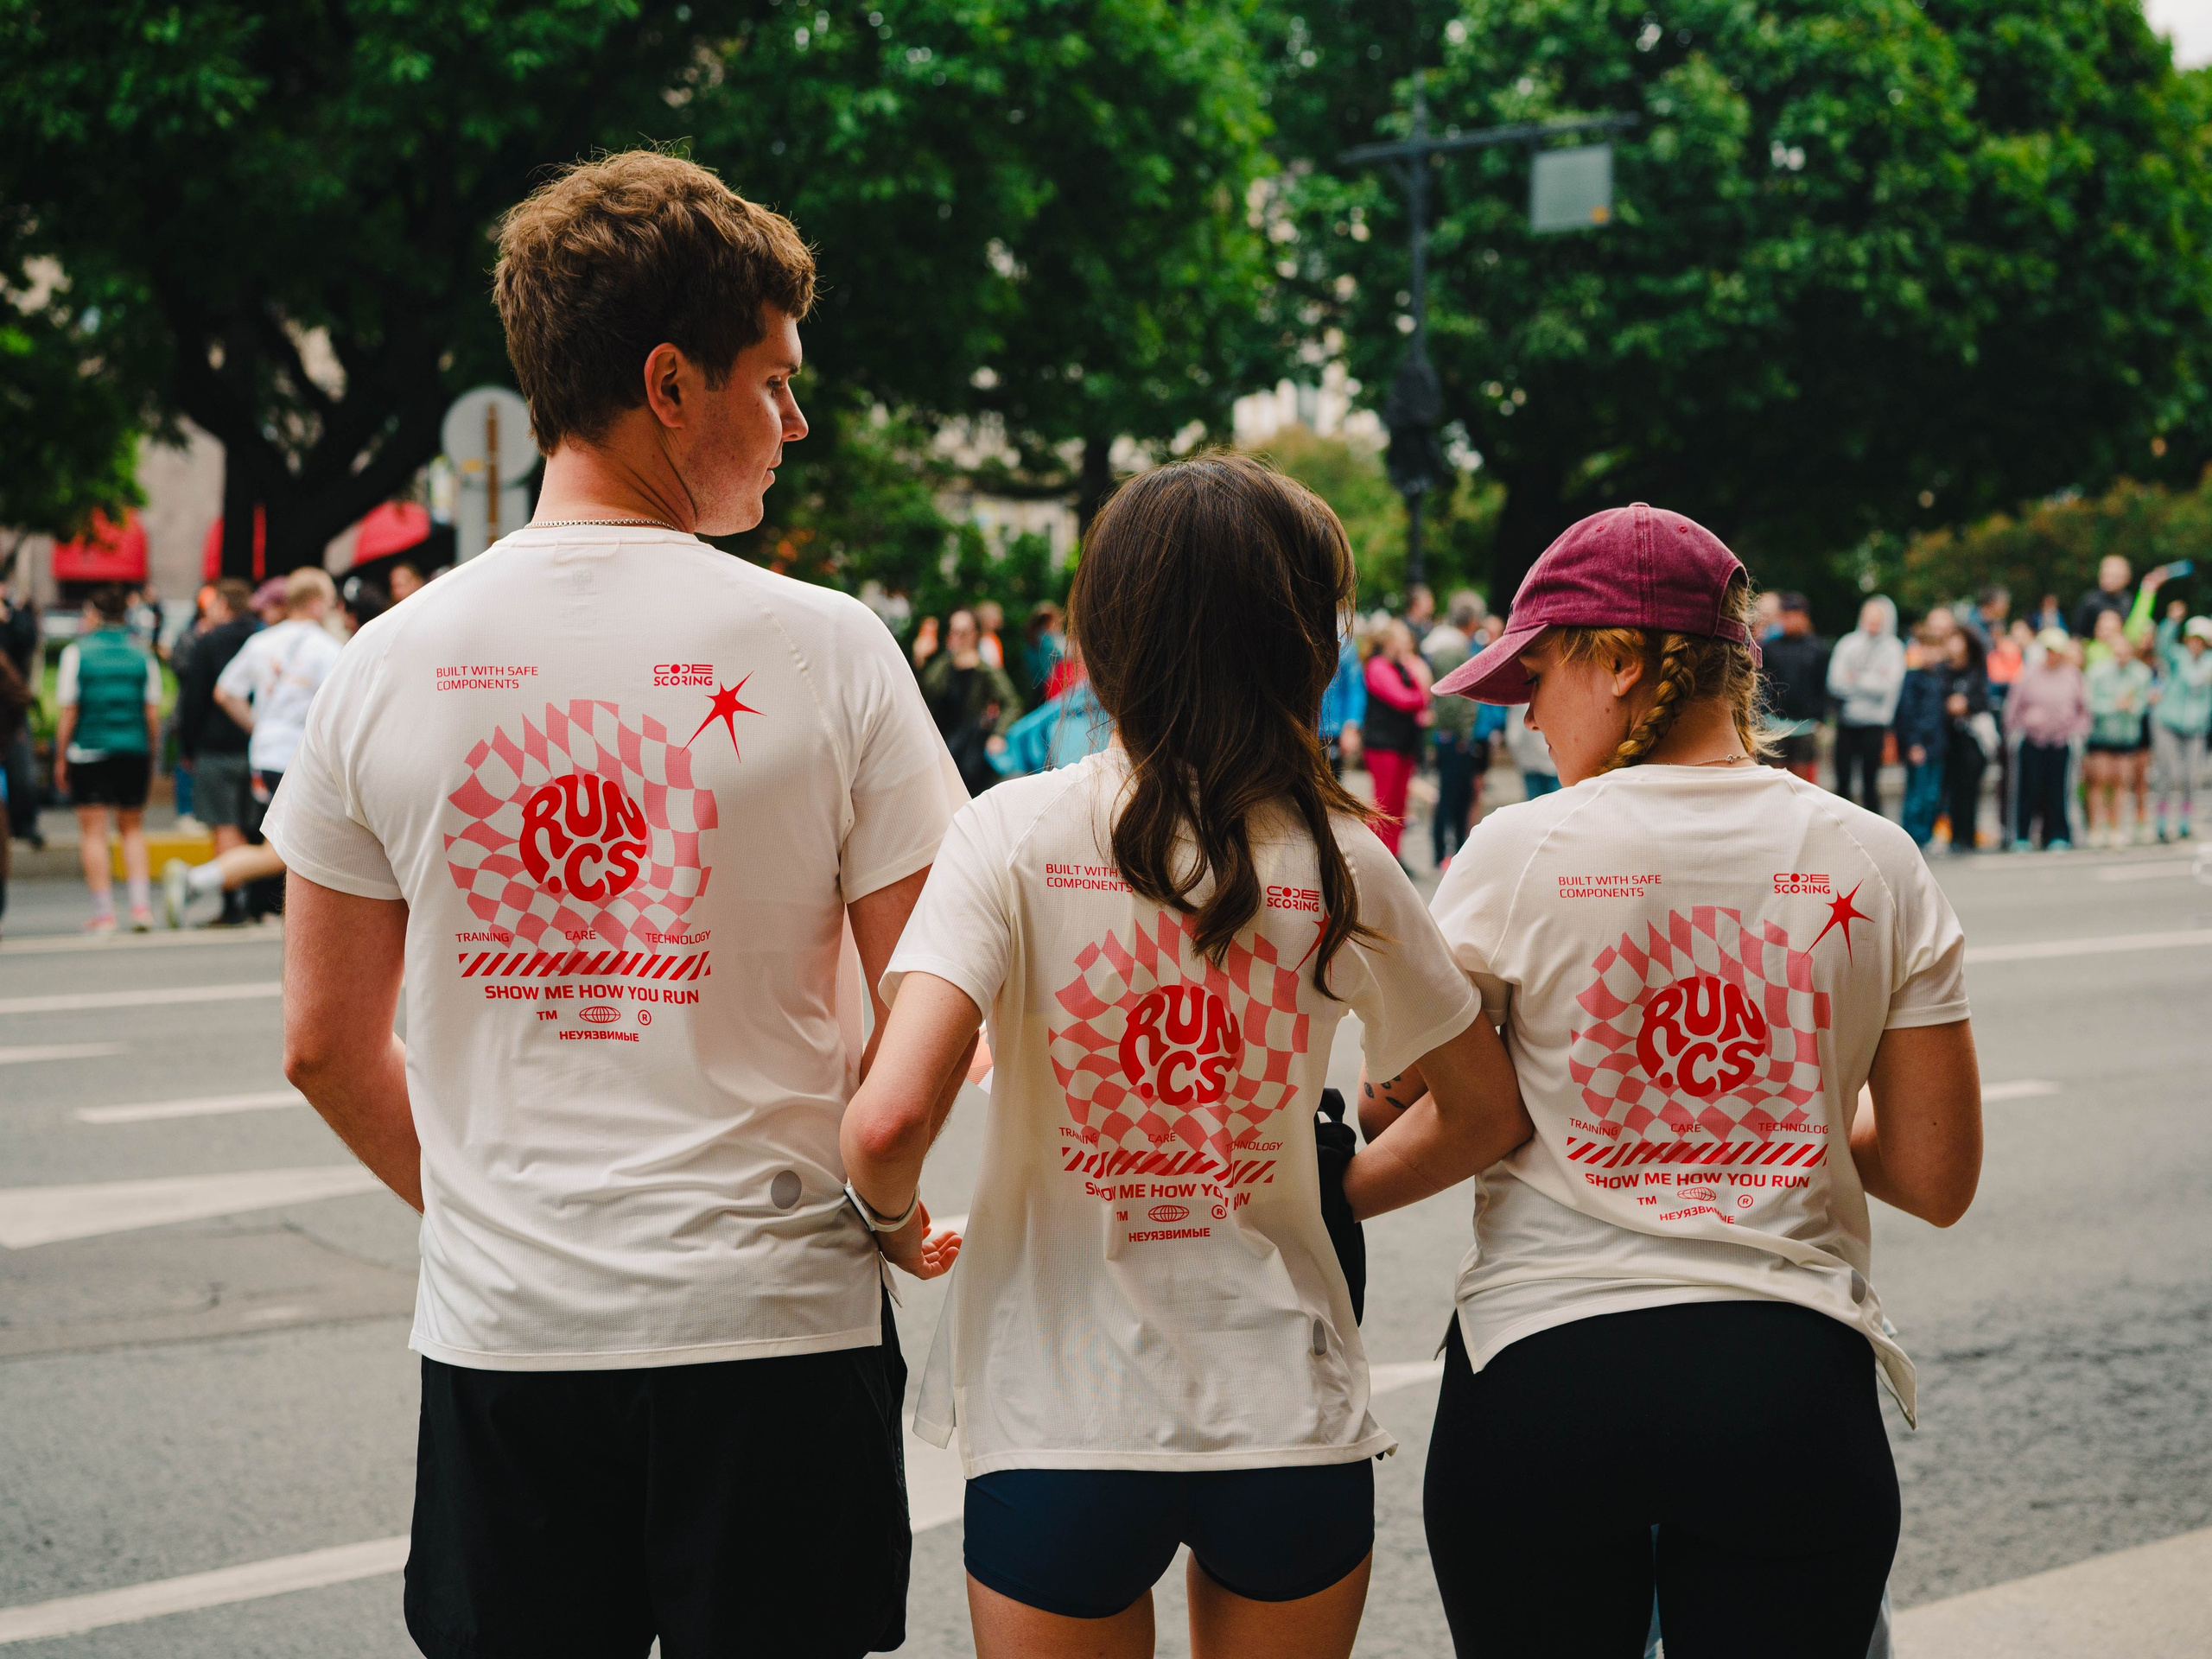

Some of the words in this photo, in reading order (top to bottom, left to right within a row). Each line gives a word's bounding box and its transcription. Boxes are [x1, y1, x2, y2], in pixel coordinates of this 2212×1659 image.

[435, 666, 468, 678] BUILT
[471, 666, 504, 677] WITH
[507, 666, 539, 677] SAFE
[653, 664, 714, 675] CODE
[436, 678, 520, 691] COMPONENTS
[653, 676, 714, 687] SCORING
[518, 773, 647, 884] RUN
[1046, 863, 1082, 875] BUILT
[1084, 866, 1119, 878] WITH
[1046, 877, 1134, 893] COMPONENTS
[1558, 875, 1593, 887] BUILT
[1595, 875, 1629, 886] WITH
[1631, 874, 1662, 886] SAFE
[1773, 873, 1830, 884] CODE
[1266, 885, 1320, 901] CODE
[1559, 887, 1644, 899] COMPONENTS
[1774, 885, 1831, 895] SCORING
[1267, 898, 1320, 912] SCORING
[455, 932, 510, 944] TRAINING
[564, 930, 596, 941] CARE
[645, 930, 712, 945] TECHNOLOGY
[484, 985, 540, 1001] SHOW
[544, 985, 575, 999] ME
[579, 984, 624, 999] HOW
[627, 985, 659, 1002] YOU
[663, 989, 700, 1004] RUN
[1636, 976, 1766, 1078] RUN
[559, 1030, 640, 1042] НЕУЯЗВИМЫЕ
[1118, 984, 1241, 1086] RUN
[1568, 1117, 1618, 1136] TRAINING
[1670, 1122, 1702, 1134] CARE
[1758, 1122, 1829, 1135] TECHNOLOG
[1147, 1132, 1177, 1143] CARE
[1585, 1173, 1640, 1190] SHOW
[1644, 1173, 1673, 1186] ME
[1676, 1173, 1723, 1186] HOW
[1726, 1173, 1767, 1187] YOU
[1771, 1175, 1811, 1189] RUN
[1120, 1184, 1147, 1199] ME
[1151, 1184, 1197, 1198] HOW
[1128, 1228, 1211, 1243] НЕУЯЗВИМЫЕ
